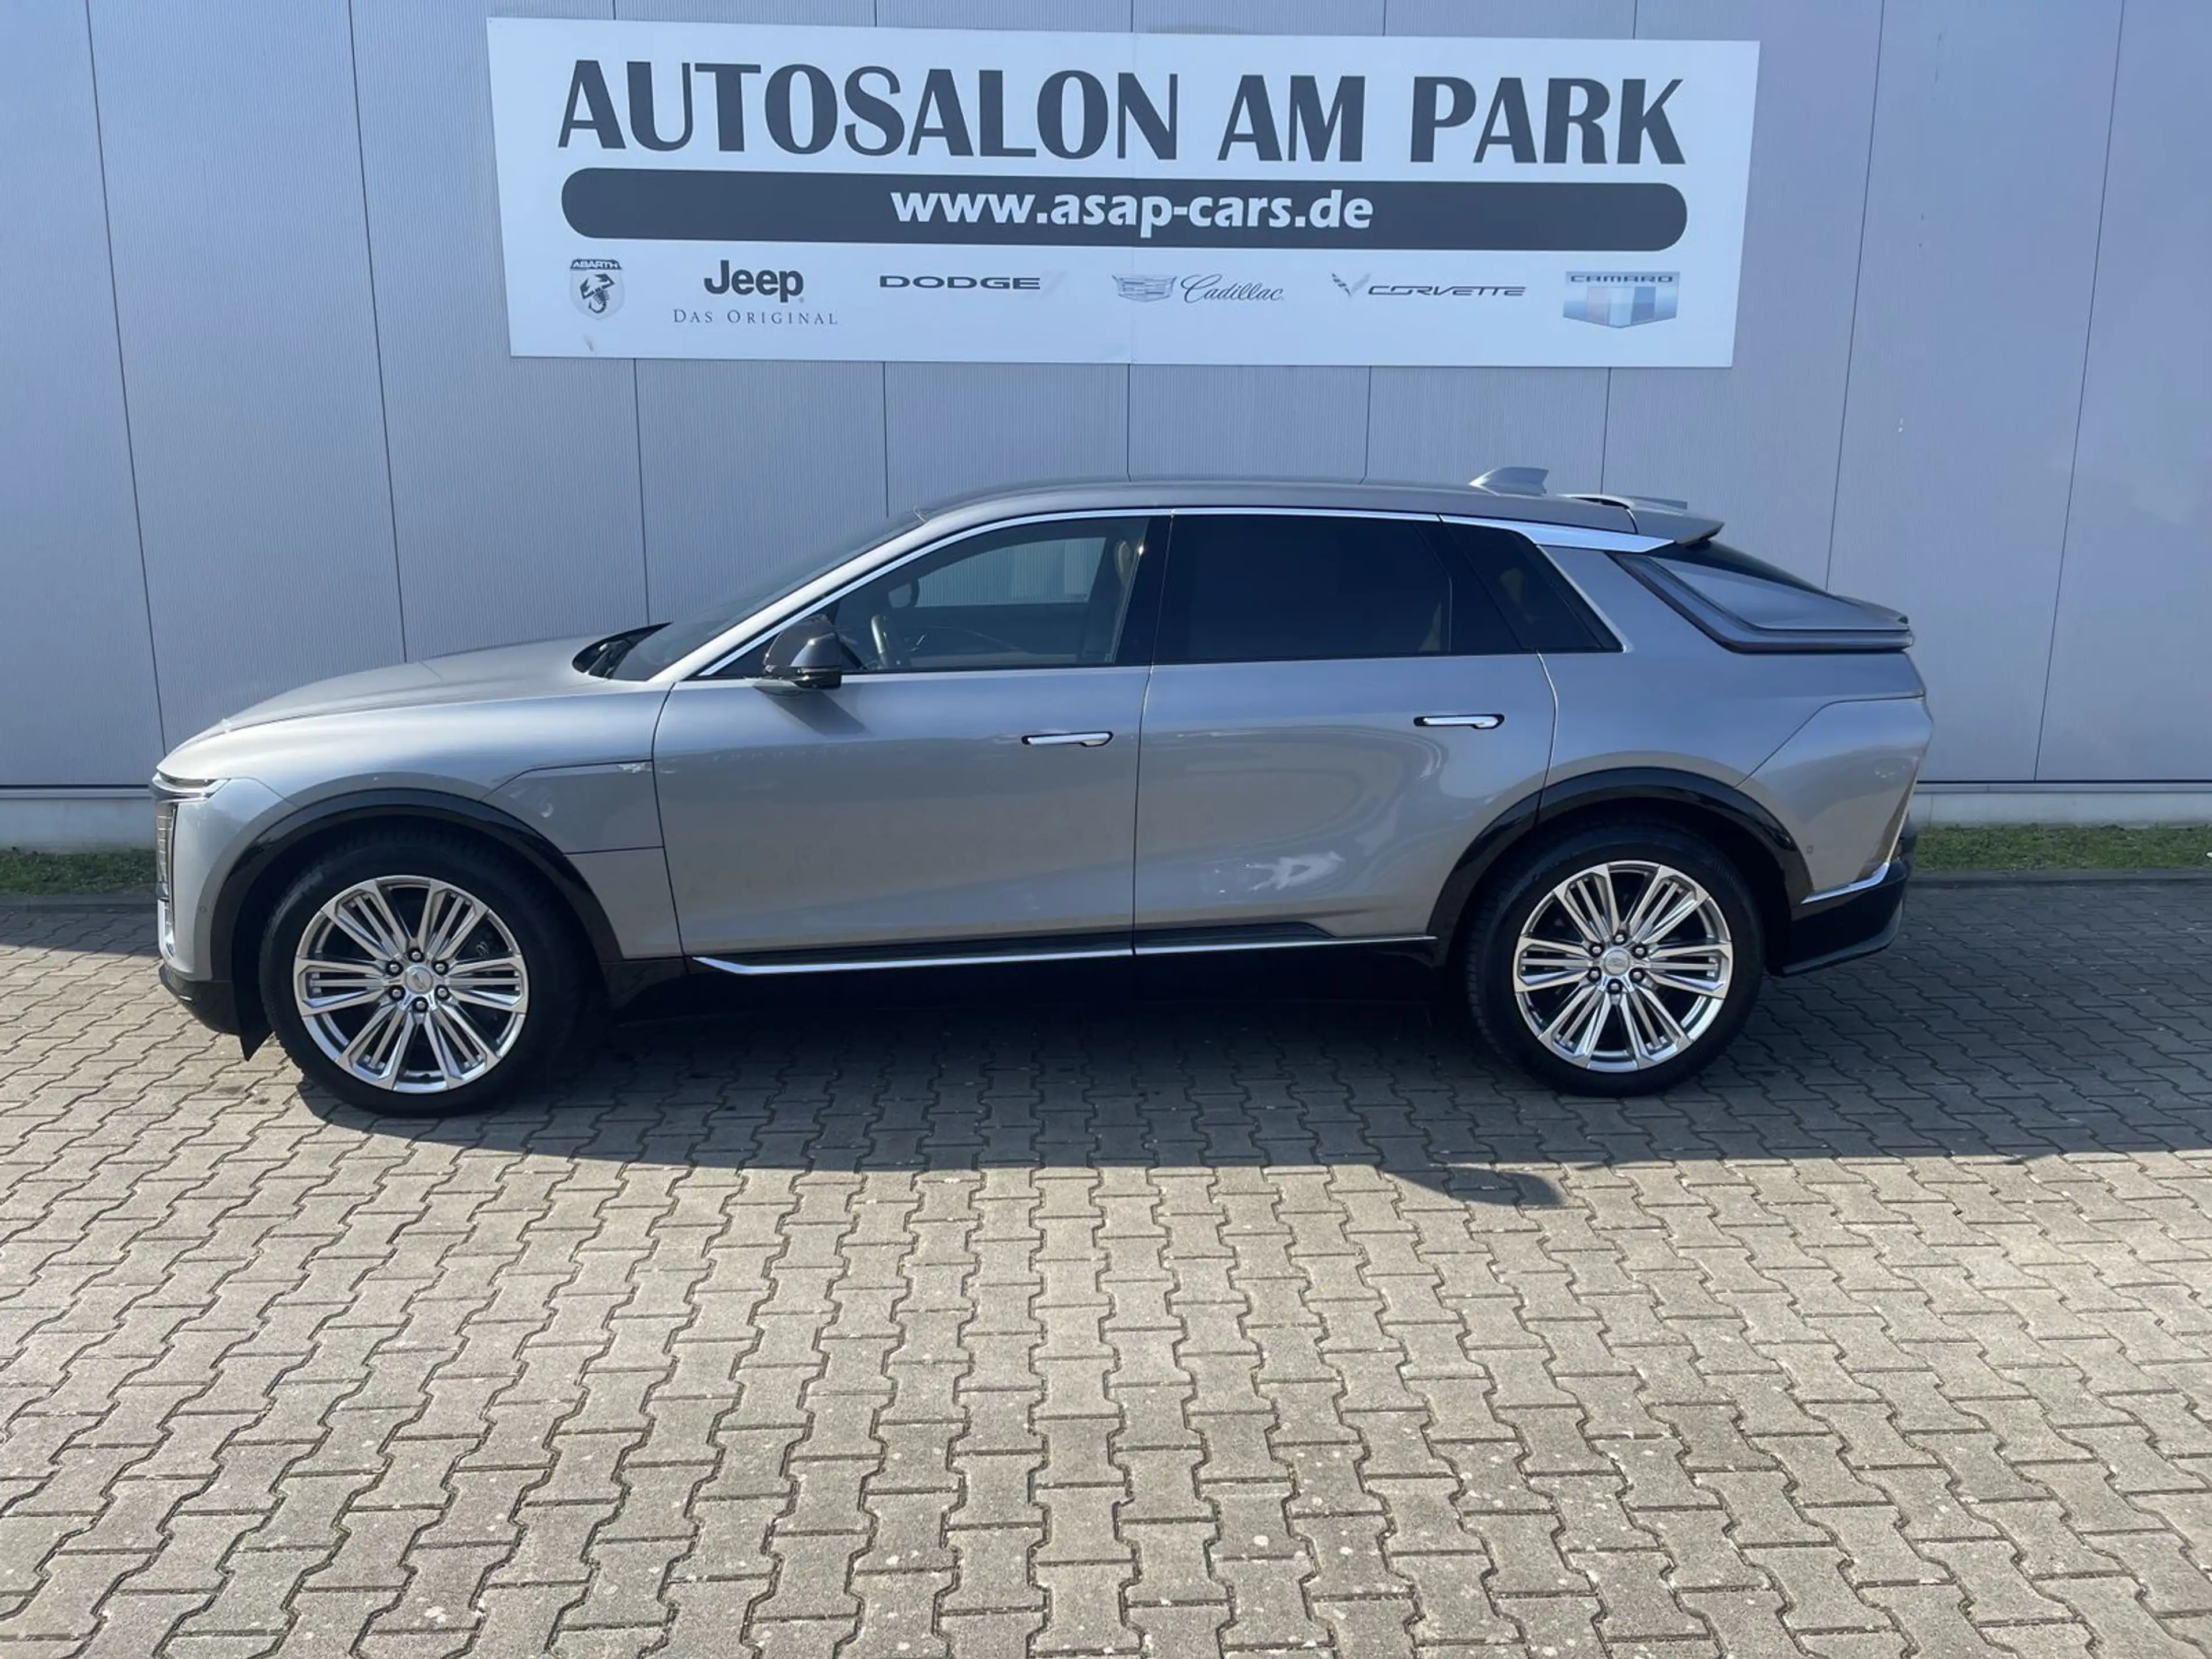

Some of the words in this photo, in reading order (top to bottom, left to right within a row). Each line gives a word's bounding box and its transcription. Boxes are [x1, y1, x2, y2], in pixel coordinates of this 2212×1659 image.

[558, 59, 1178, 160] AUTOSALON
[1217, 73, 1366, 162] AM
[1409, 75, 1686, 165] PARK
[890, 189, 1374, 237] www.asap-cars.de
[573, 260, 620, 269] ABARTH
[703, 260, 804, 303] Jeep
[879, 275, 1041, 290] DODGE
[1570, 275, 1673, 283] CAMARO
[1180, 273, 1283, 304] Cadillac
[1368, 286, 1527, 296] CORVETTE
[673, 309, 714, 324] DAS
[727, 309, 838, 325] ORIGINAL
